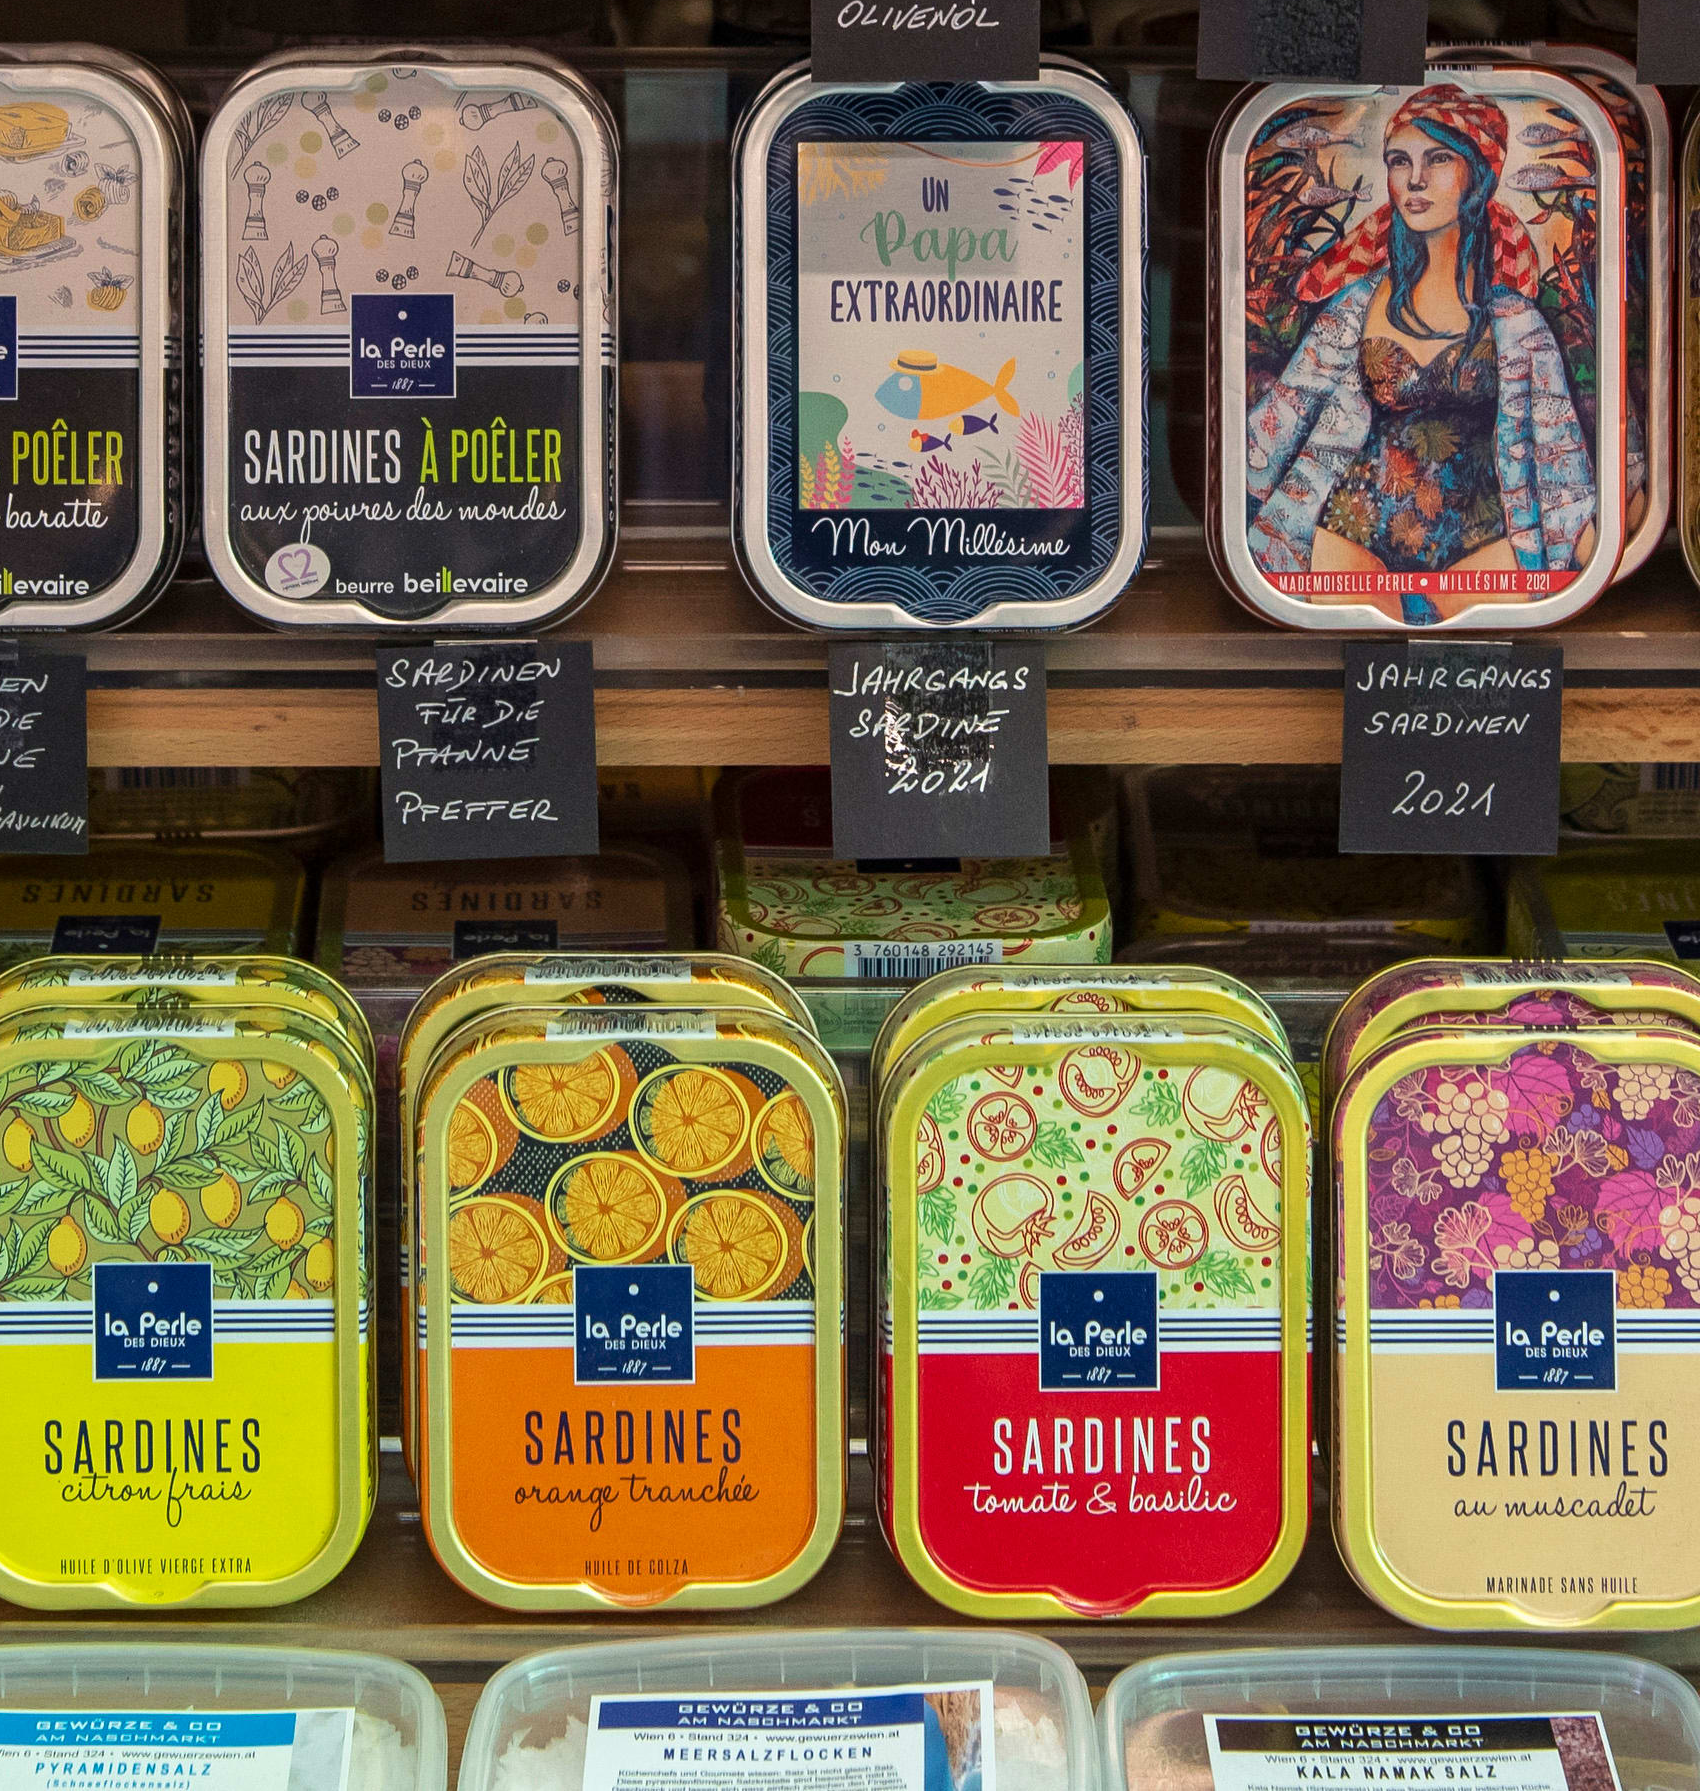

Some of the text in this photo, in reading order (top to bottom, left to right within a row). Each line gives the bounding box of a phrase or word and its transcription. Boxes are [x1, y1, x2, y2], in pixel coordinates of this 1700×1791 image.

[922, 177, 949, 216] UN
[859, 210, 1018, 282] Papa
[830, 279, 1064, 327] EXTRAORDINAIRE
[812, 516, 1071, 560] Mon Millésime
[1279, 569, 1551, 592] MADEMOISELLE PERLE MILLÉSIME 2021
[1356, 661, 1552, 691] JAHRGANGS
[1364, 712, 1530, 737] SARDINEN
[1392, 770, 1500, 817] 2021
[874, 943, 930, 957] 760148
[938, 942, 994, 956] 292145
[44, 1417, 262, 1475] SARDINES
[525, 1409, 743, 1467] SARDINES
[993, 1417, 1212, 1477] SARDINES
[1446, 1420, 1669, 1479] SARDINES
[514, 1475, 760, 1531] orange tranchée
[34, 1760, 212, 1778] PYRAMIDENSALZ
[662, 1745, 874, 1761] MEERSALZFLOCKEN
